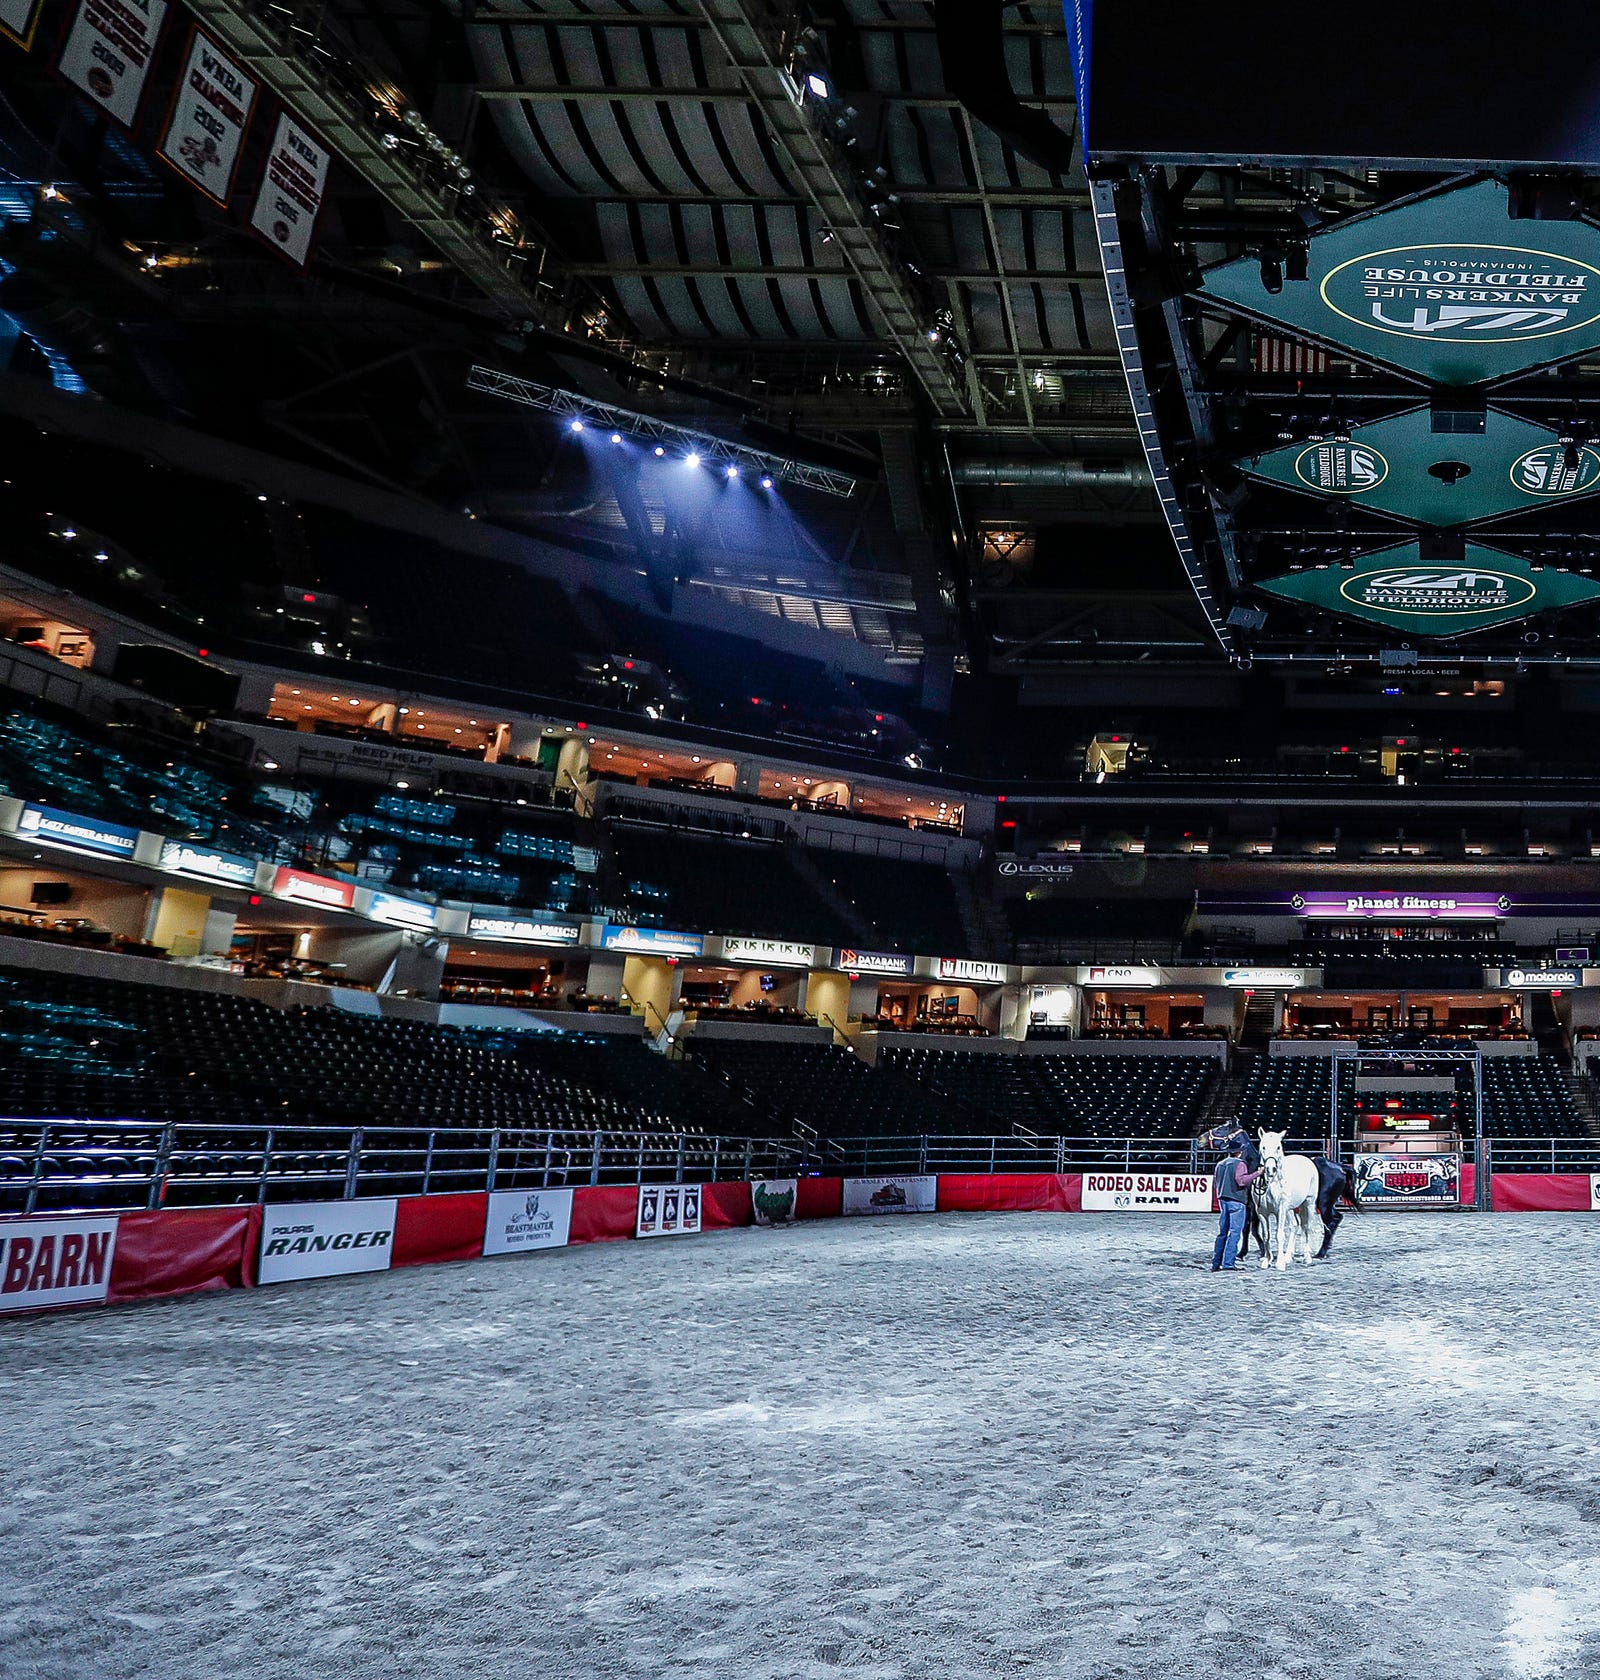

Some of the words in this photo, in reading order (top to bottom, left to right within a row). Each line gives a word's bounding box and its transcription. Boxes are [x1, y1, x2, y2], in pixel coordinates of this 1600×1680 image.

[202, 50, 243, 102] WNBA
[194, 104, 226, 142] 2012
[288, 129, 318, 169] WNBA
[1423, 259, 1533, 270] INDIANAPOLIS
[1364, 267, 1588, 287] FIELDHOUSE
[1364, 286, 1420, 298] LIFE
[1427, 288, 1582, 304] BANKERS
[1319, 447, 1331, 487] FIELDHOUSE
[1336, 448, 1346, 474] BANKERS
[1364, 587, 1467, 597] BANKERS
[1470, 589, 1507, 597] LIFE
[1364, 596, 1506, 605] FIELDHOUSE
[1383, 668, 1406, 676] FRESH
[1411, 668, 1435, 676] LOCAL
[1441, 668, 1460, 676] BEER
[352, 744, 390, 759] NEED
[392, 751, 434, 767] HELP?
[1019, 864, 1073, 873] LEXUS
[1346, 896, 1400, 911] planet
[1402, 896, 1456, 909] fitness
[469, 918, 514, 931] SPORT
[514, 921, 578, 939] GRAPHICS
[857, 955, 906, 969] DATABANK
[1525, 972, 1575, 982] motorola
[1388, 1162, 1423, 1170] CINCH
[1088, 1175, 1133, 1191] RODEO
[1147, 1176, 1180, 1192] SALE
[1184, 1177, 1217, 1193] DAYS
[1135, 1196, 1180, 1204] RAM
[272, 1224, 315, 1235] POLARIS
[505, 1220, 554, 1234] BEASTMASTER
[264, 1230, 391, 1256] RANGER
[1, 1231, 113, 1294] BARN
